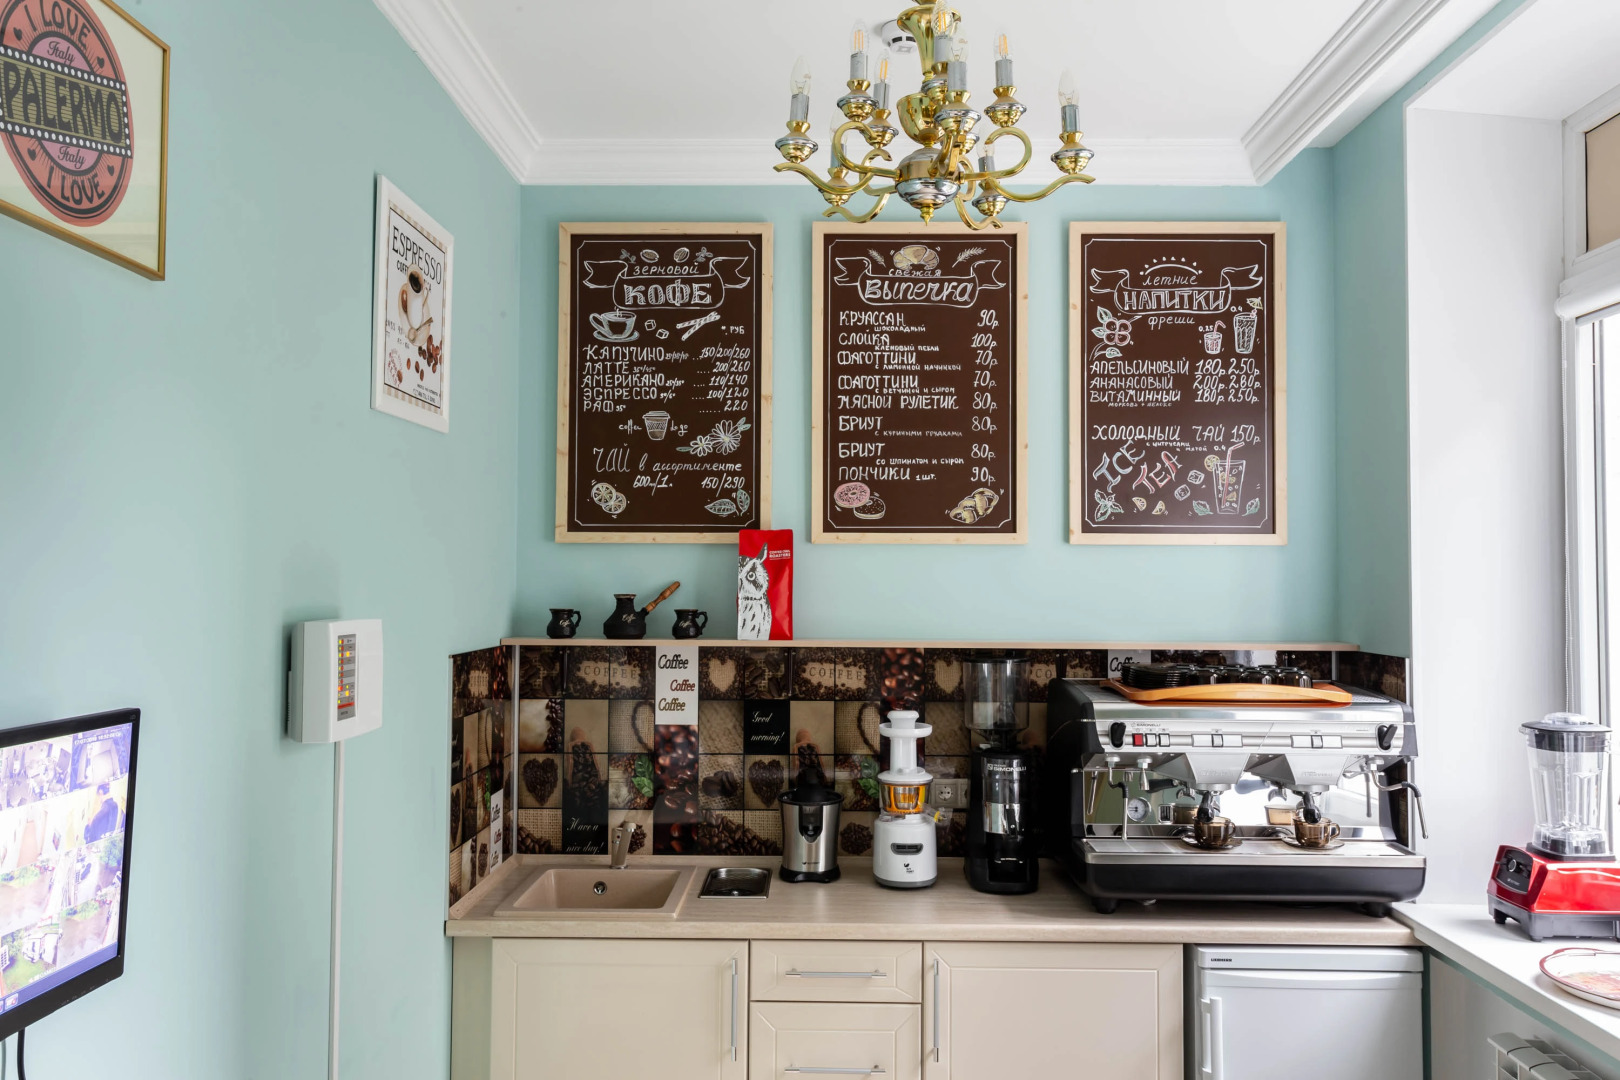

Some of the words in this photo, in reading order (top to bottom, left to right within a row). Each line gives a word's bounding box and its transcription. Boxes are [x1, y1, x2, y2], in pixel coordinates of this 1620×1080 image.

[24, 5, 37, 32] I
[41, 0, 91, 49] LOVE
[47, 41, 75, 65] Italy
[2, 62, 123, 144] PALERMO
[57, 146, 87, 170] Italy
[46, 165, 54, 189] I
[60, 174, 105, 206] LOVE
[392, 225, 441, 284] ESPRESSO
[633, 262, 700, 275] зерновой
[888, 268, 942, 277] свежая
[1142, 273, 1198, 286] летние
[624, 279, 712, 306] КОФЕ
[865, 279, 973, 301] Выпечка
[1123, 290, 1226, 310] НАПИТКИ
[839, 311, 906, 326] КРУАССАН
[1148, 315, 1196, 331] фреши
[838, 328, 890, 346] СЛОЙКА
[583, 345, 665, 361] КАПУЧИНО
[837, 351, 916, 365] ФАГОТТИНИ
[583, 361, 630, 374] ЛАТТЕ
[1089, 357, 1189, 375] АПЕЛЬСИНОВЫЙ
[581, 373, 665, 387] АМЕРИКАНО
[838, 375, 919, 389] ФАГОТТИНИ
[1089, 374, 1173, 389] АНАНАСОВЫЙ
[583, 387, 657, 400] ЭСПРЕССО
[1089, 389, 1181, 402] ВИТАМИННЫЙ
[583, 400, 614, 412] РАФ
[724, 400, 748, 411] 220
[838, 395, 891, 409] МЯСНОЙ
[900, 395, 959, 409] РУЛЕТИК
[838, 416, 883, 431] БРИУТ
[1092, 425, 1180, 440] ХОЛОДНЫЙ
[1192, 424, 1225, 442] ЧАЙ
[838, 442, 885, 458] БРИУТ
[593, 443, 631, 473] ЧАЙ
[652, 461, 743, 475] ассортименте
[1093, 440, 1145, 493] ICE
[838, 466, 911, 481] ПОНЧИКИ
[1132, 450, 1183, 494] TEA
[658, 654, 689, 669] Coffee
[584, 665, 637, 679] COFFEE
[809, 667, 863, 680] COFFEE
[670, 679, 696, 692] Coffee
[658, 698, 686, 712] Coffee
[752, 711, 773, 722] Good
[751, 732, 785, 745] morning!
